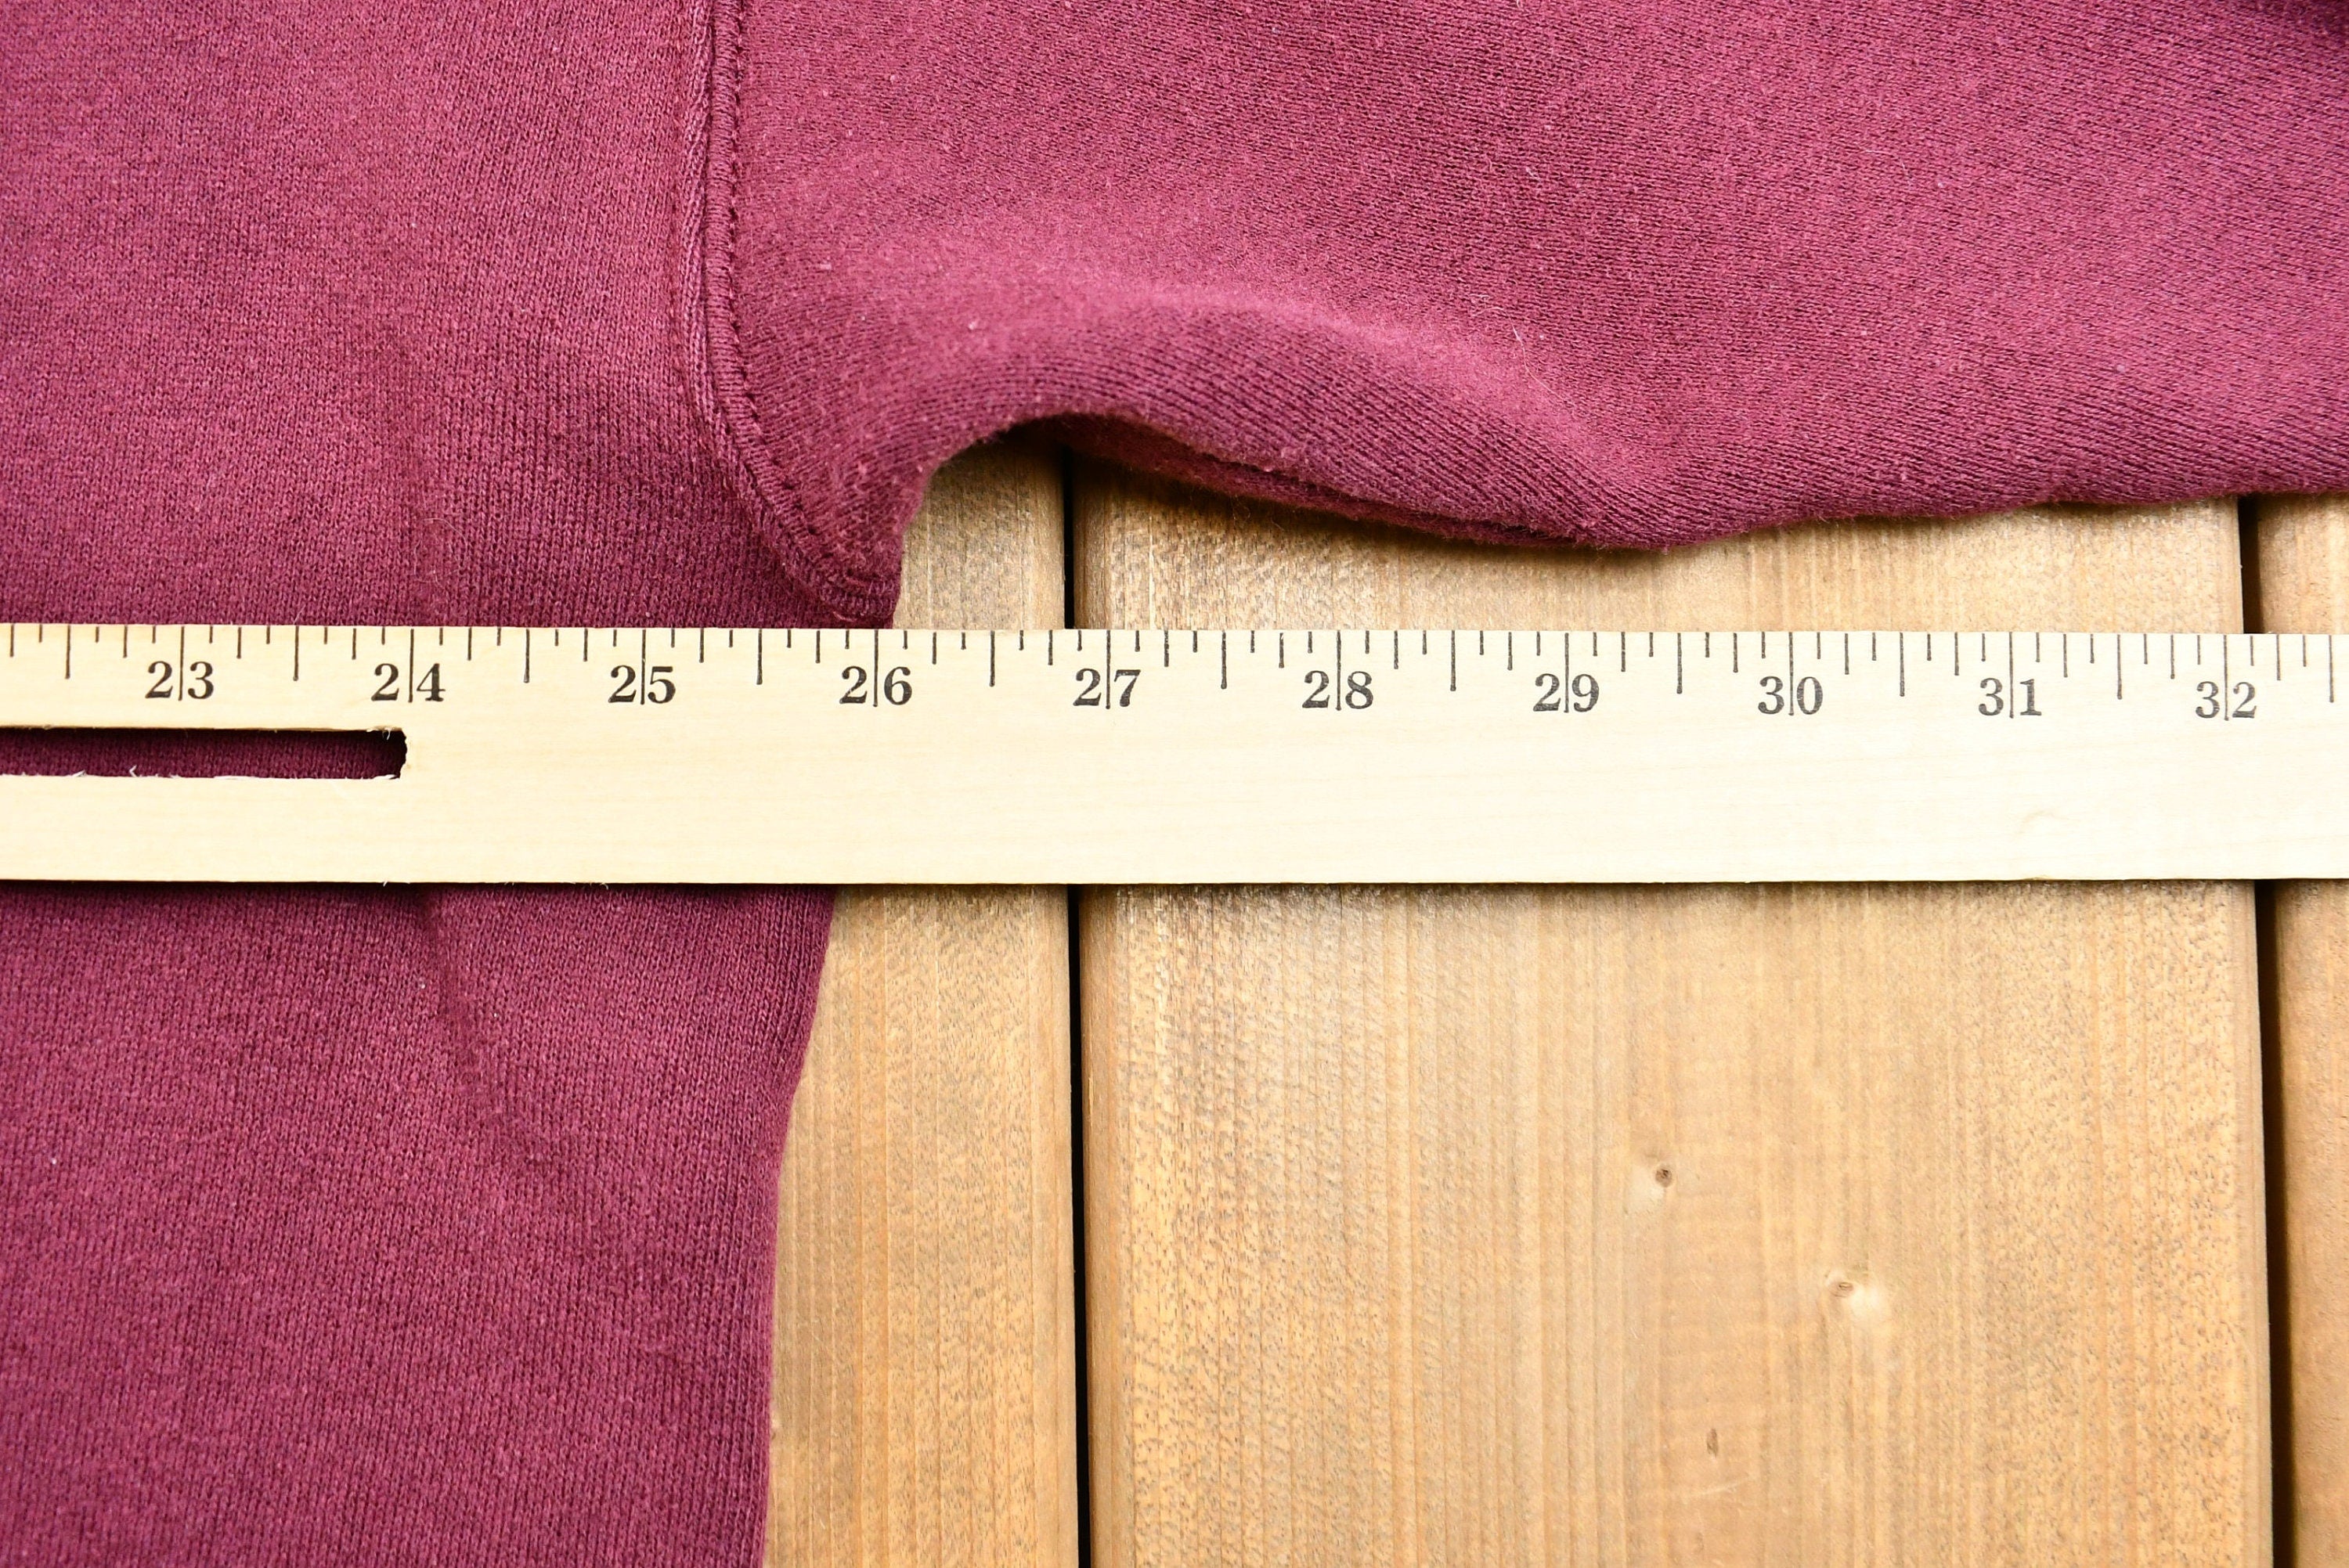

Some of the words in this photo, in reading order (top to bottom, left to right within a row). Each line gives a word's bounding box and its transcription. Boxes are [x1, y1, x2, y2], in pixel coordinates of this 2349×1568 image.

[146, 661, 215, 700] 23
[371, 663, 446, 702] 24
[608, 665, 676, 704] 25
[839, 666, 912, 705] 26
[1073, 669, 1141, 708] 27
[1301, 671, 1373, 709] 28
[1533, 673, 1600, 712] 29
[1758, 676, 1823, 715] 30
[1978, 678, 2042, 716] 31
[2195, 681, 2257, 719] 32
